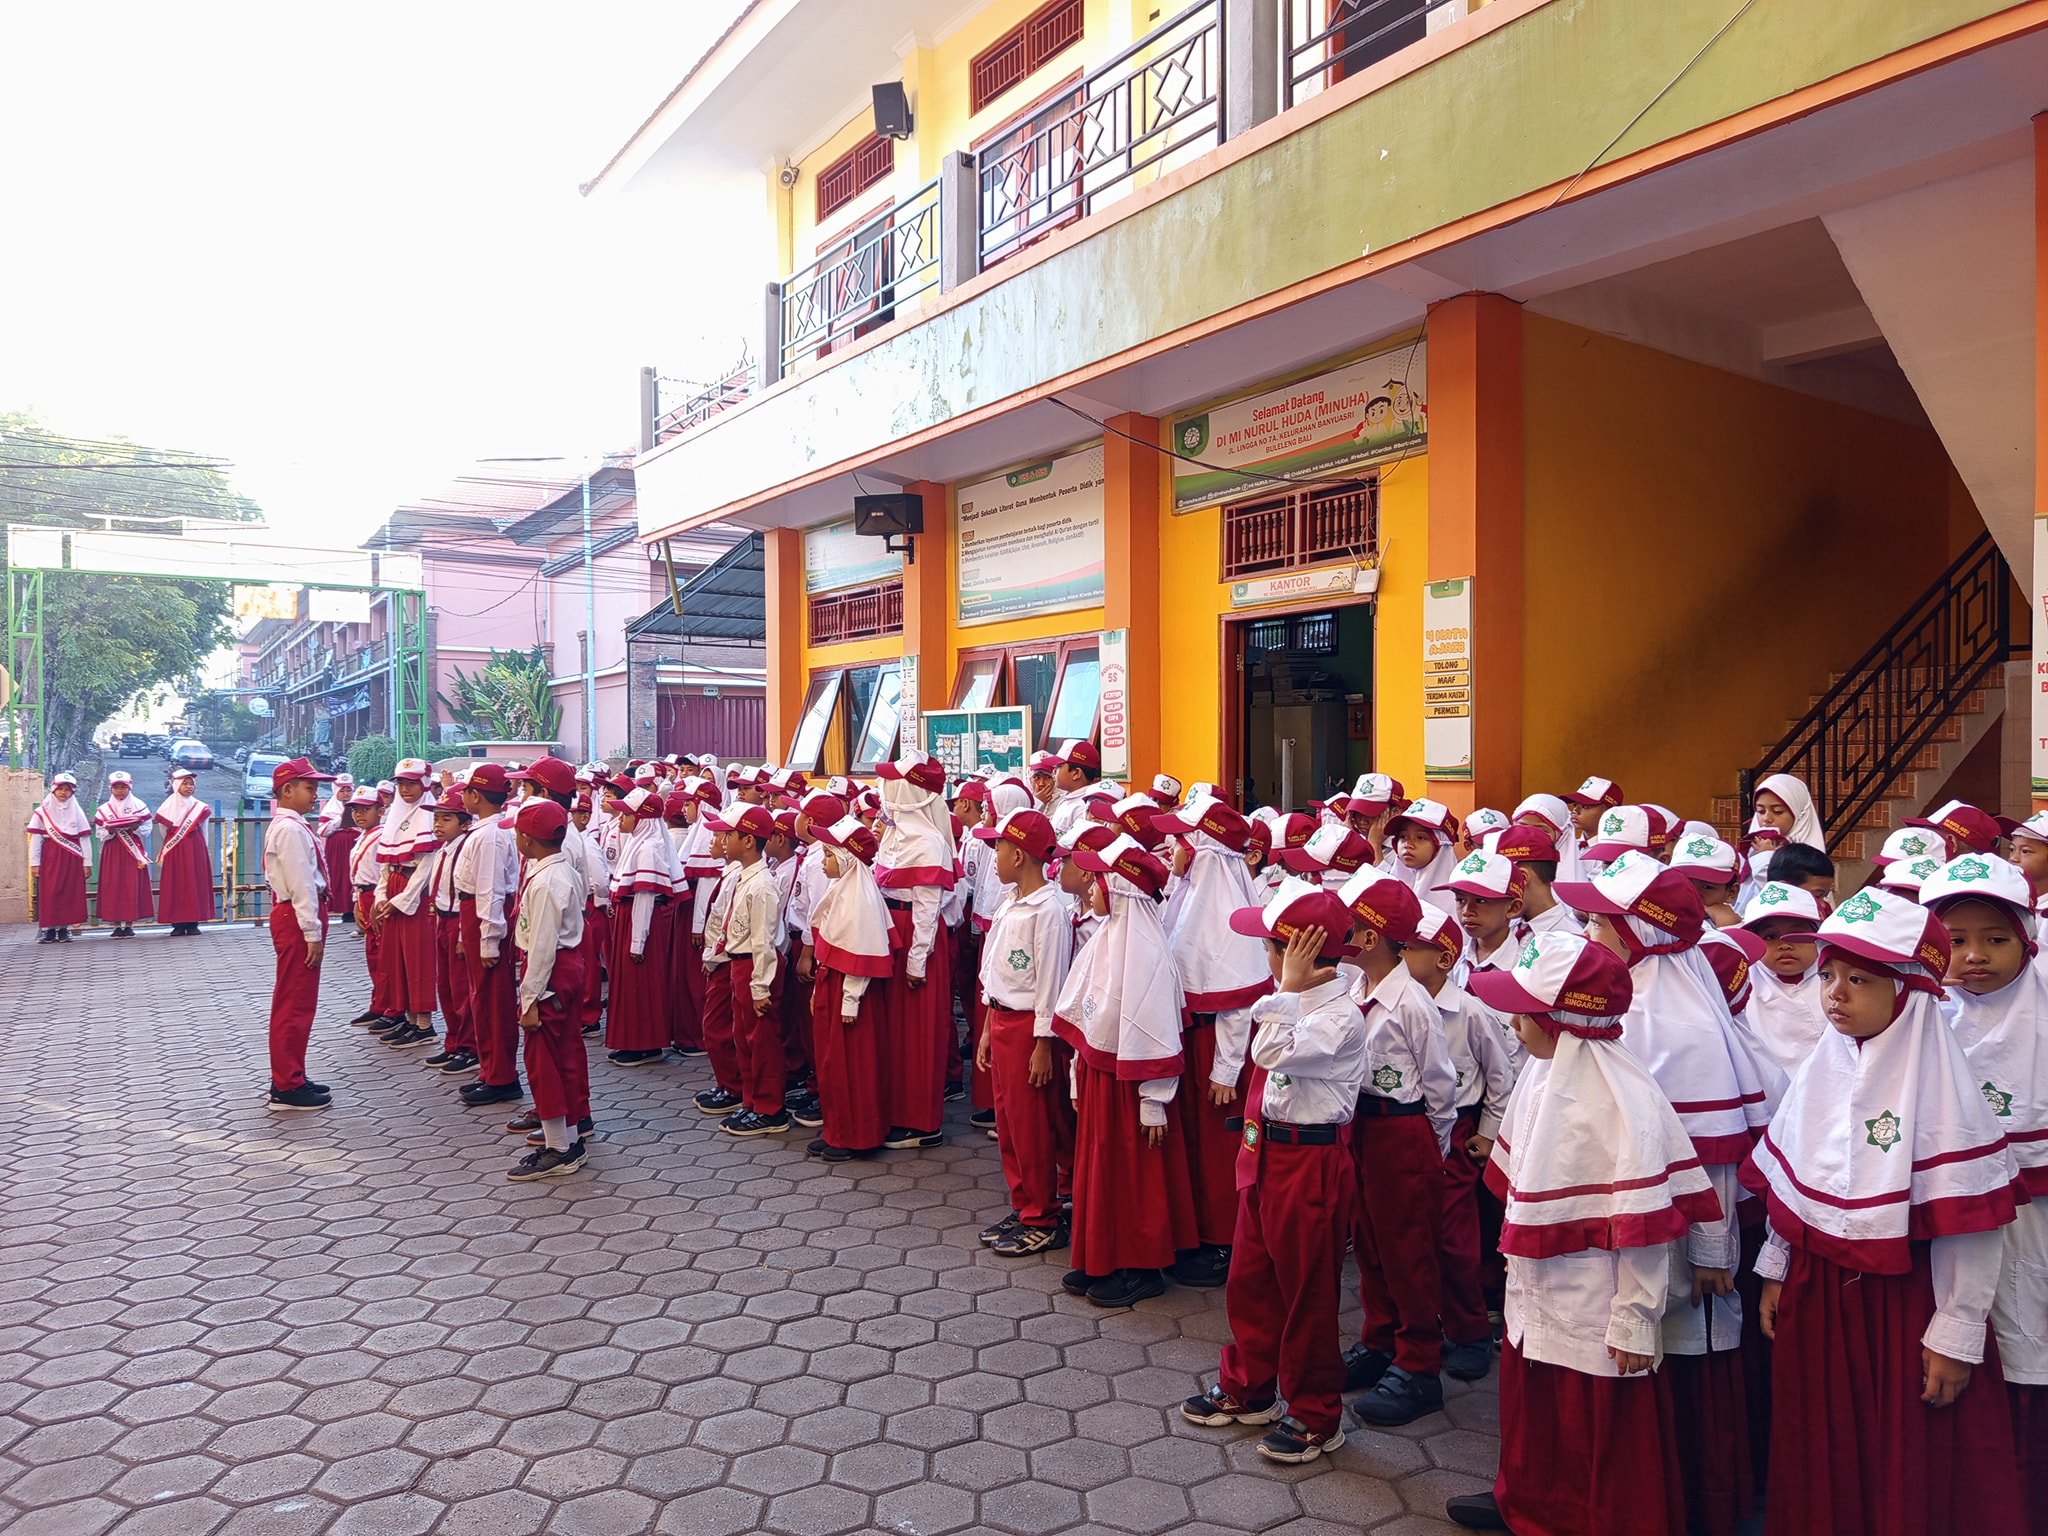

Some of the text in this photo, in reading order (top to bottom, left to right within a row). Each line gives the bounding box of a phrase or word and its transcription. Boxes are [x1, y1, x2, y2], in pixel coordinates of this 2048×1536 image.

[1252, 390, 1325, 422] Selamat Datang
[1216, 390, 1370, 448] DI MI NURUL HUDA (MINUHA)
[1236, 441, 1258, 452] LINGGA
[1258, 438, 1268, 446] NO
[1279, 423, 1317, 440] KELURAHAN
[1317, 410, 1355, 429] BANYUASRI
[1265, 433, 1313, 454] BULELENG BALI
[981, 507, 998, 518] Sekolah
[1029, 491, 1057, 505] Membentuk
[1058, 485, 1077, 497] Peserta
[1080, 480, 1094, 491] Didik
[1062, 516, 1072, 525] didik
[1270, 576, 1311, 591] KANTOR
[1425, 627, 1468, 642] 4 KATA
[1429, 641, 1466, 656] AJAIB
[1433, 660, 1459, 670] TOLONG
[1107, 671, 1118, 683] 5S
[1437, 675, 1456, 685] MAAF
[1426, 690, 1465, 700] TERIMA KASIH
[1433, 706, 1460, 716] PERMISI
[1564, 997, 1605, 1011] SINGARAJA
[1573, 992, 1592, 1002] NURUL
[1592, 996, 1608, 1004] HUDA
